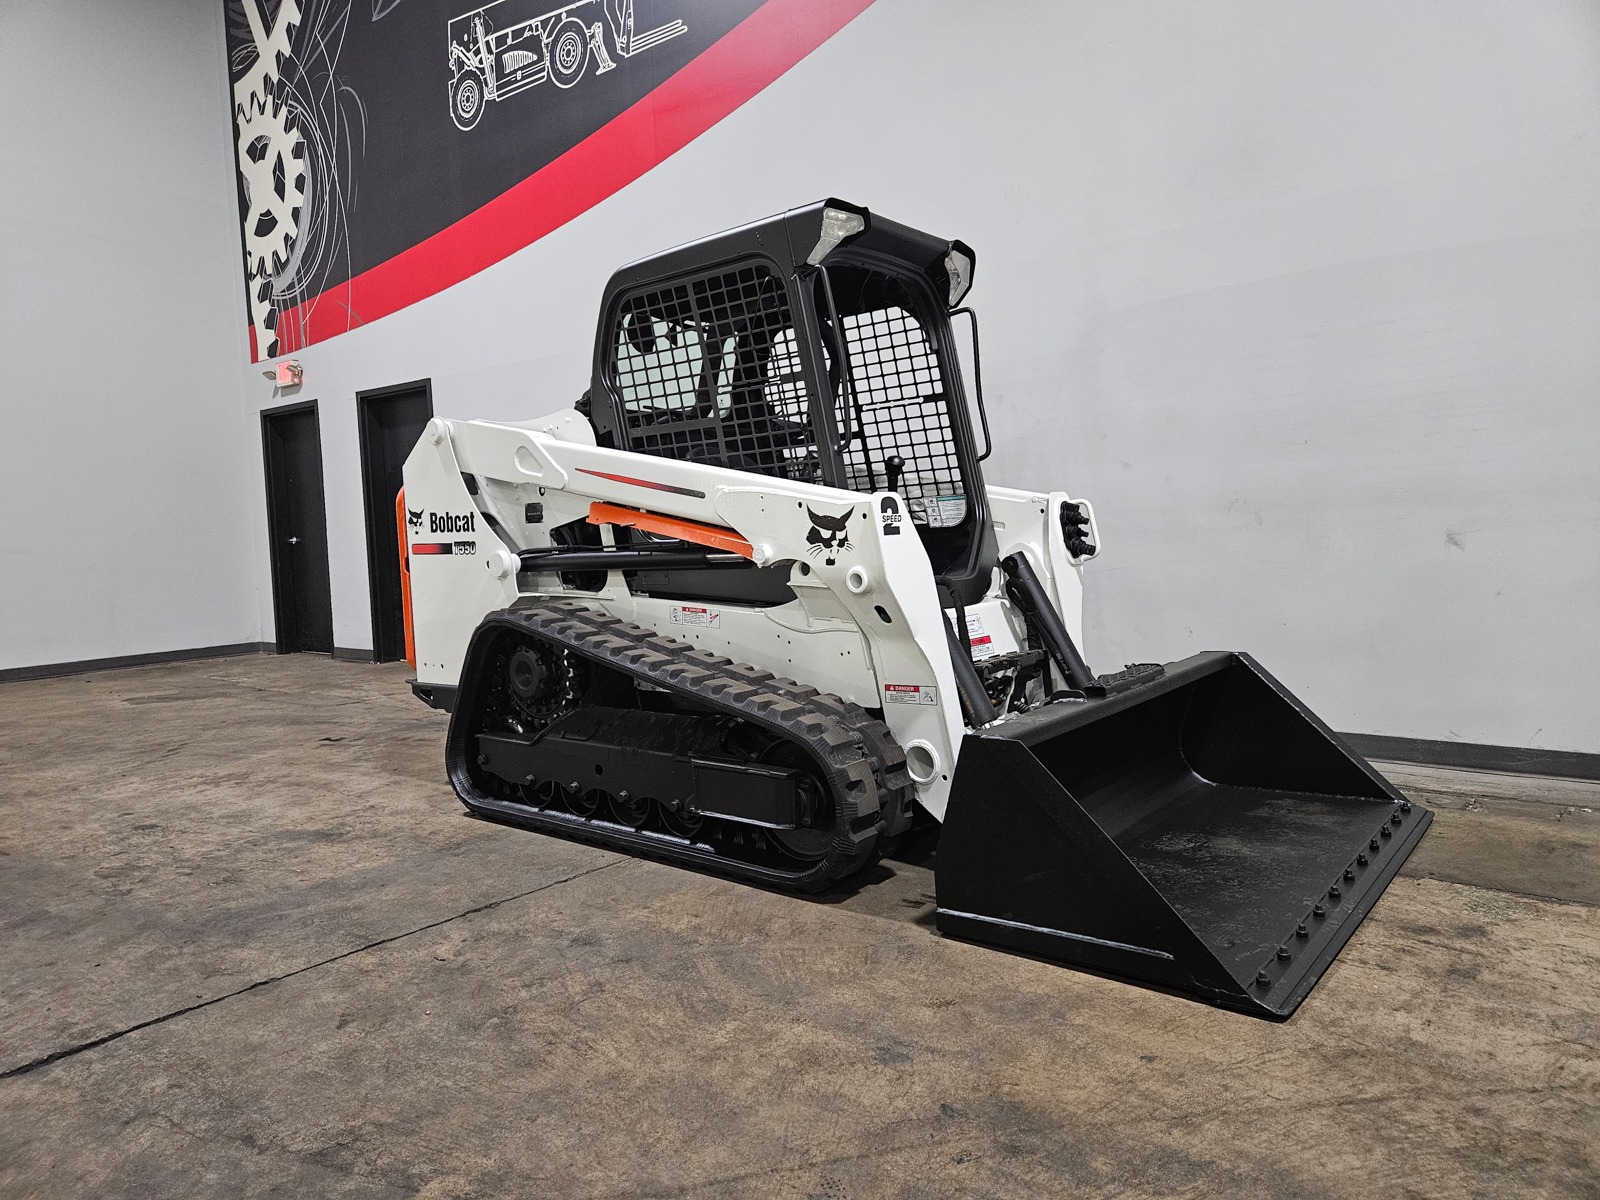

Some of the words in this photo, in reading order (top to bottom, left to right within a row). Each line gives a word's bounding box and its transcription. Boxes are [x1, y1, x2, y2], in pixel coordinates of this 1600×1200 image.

[430, 512, 475, 533] Bobcat
[882, 514, 902, 523] SPEED
[454, 541, 476, 555] T550
